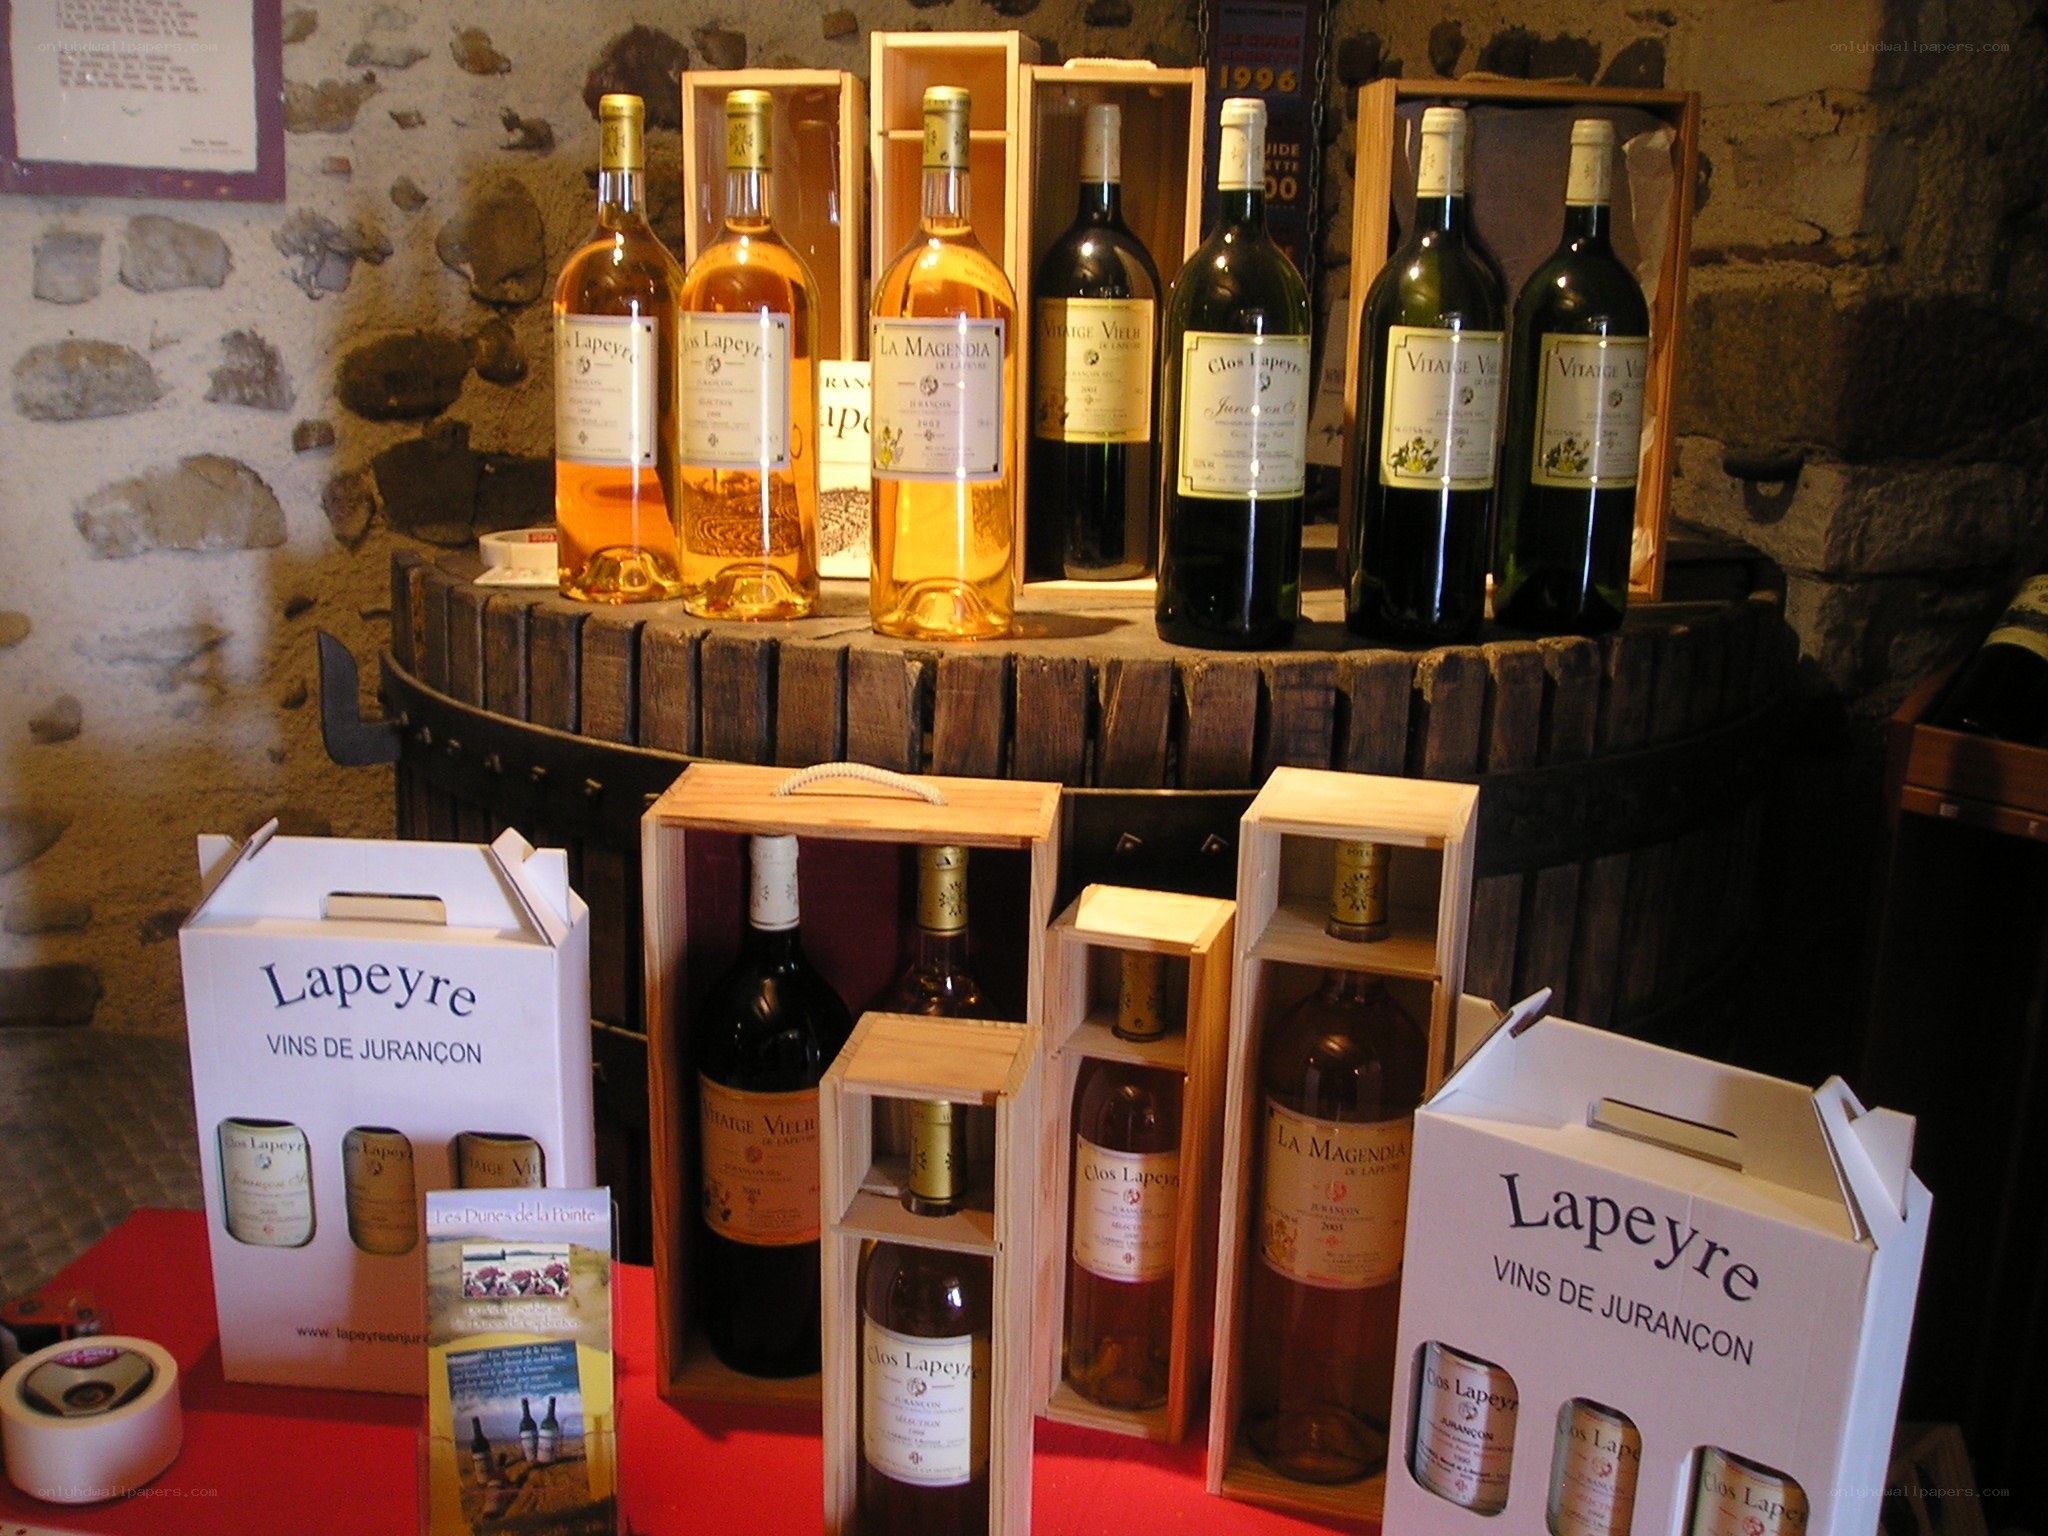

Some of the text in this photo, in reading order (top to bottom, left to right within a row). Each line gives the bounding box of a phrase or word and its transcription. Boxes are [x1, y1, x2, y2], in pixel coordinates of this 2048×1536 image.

[1219, 65, 1297, 93] 1996
[704, 329, 772, 359] Lapeyr
[880, 335, 991, 358] LA MAGENDIA
[1208, 356, 1244, 374] Clos
[260, 961, 477, 1018] Lapeyre
[266, 1033, 482, 1065] VINS DE JURANÇON
[1276, 1123, 1406, 1164] LA MAGENDIA
[1084, 1163, 1116, 1182] Clos
[464, 1207, 512, 1224] Dunes
[515, 1201, 534, 1223] de
[536, 1200, 549, 1223] la
[552, 1205, 596, 1223] Pointe
[1499, 1172, 1760, 1302] Lapeyre
[1493, 1255, 1754, 1365] VINS DE JURANÇON
[867, 1345, 899, 1368] Clos
